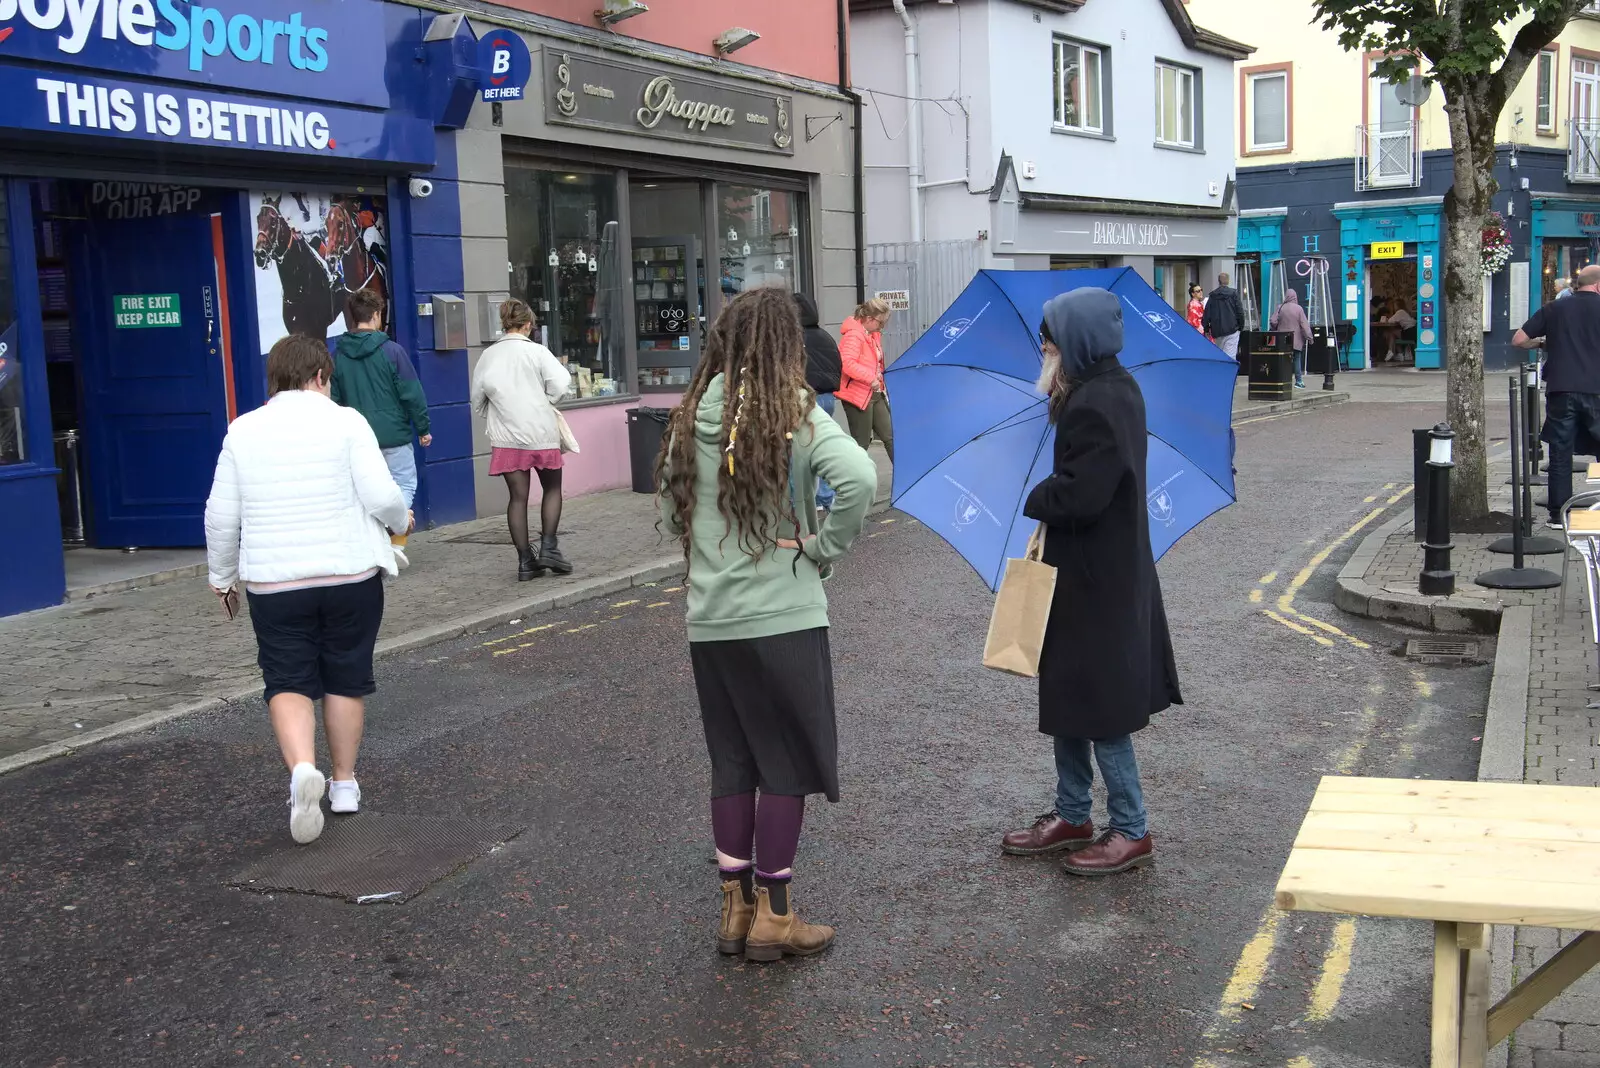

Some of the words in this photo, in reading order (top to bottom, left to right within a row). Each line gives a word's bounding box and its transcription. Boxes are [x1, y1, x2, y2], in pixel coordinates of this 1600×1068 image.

[485, 88, 499, 98] BET
[500, 87, 520, 97] HERE
[637, 76, 736, 131] Grappa
[37, 78, 136, 132] THIS
[143, 93, 181, 136] IS
[187, 98, 336, 150] BETTING.
[157, 188, 201, 215] APP
[1093, 221, 1137, 245] BARGAIN
[1138, 223, 1168, 246] SHOES
[1377, 246, 1397, 254] EXIT
[879, 292, 905, 300] PRIVATE
[121, 297, 144, 310] FIRE
[148, 296, 171, 309] EXIT
[892, 301, 908, 309] PARK
[117, 313, 143, 325] KEEP
[147, 312, 180, 324] CLEAR
